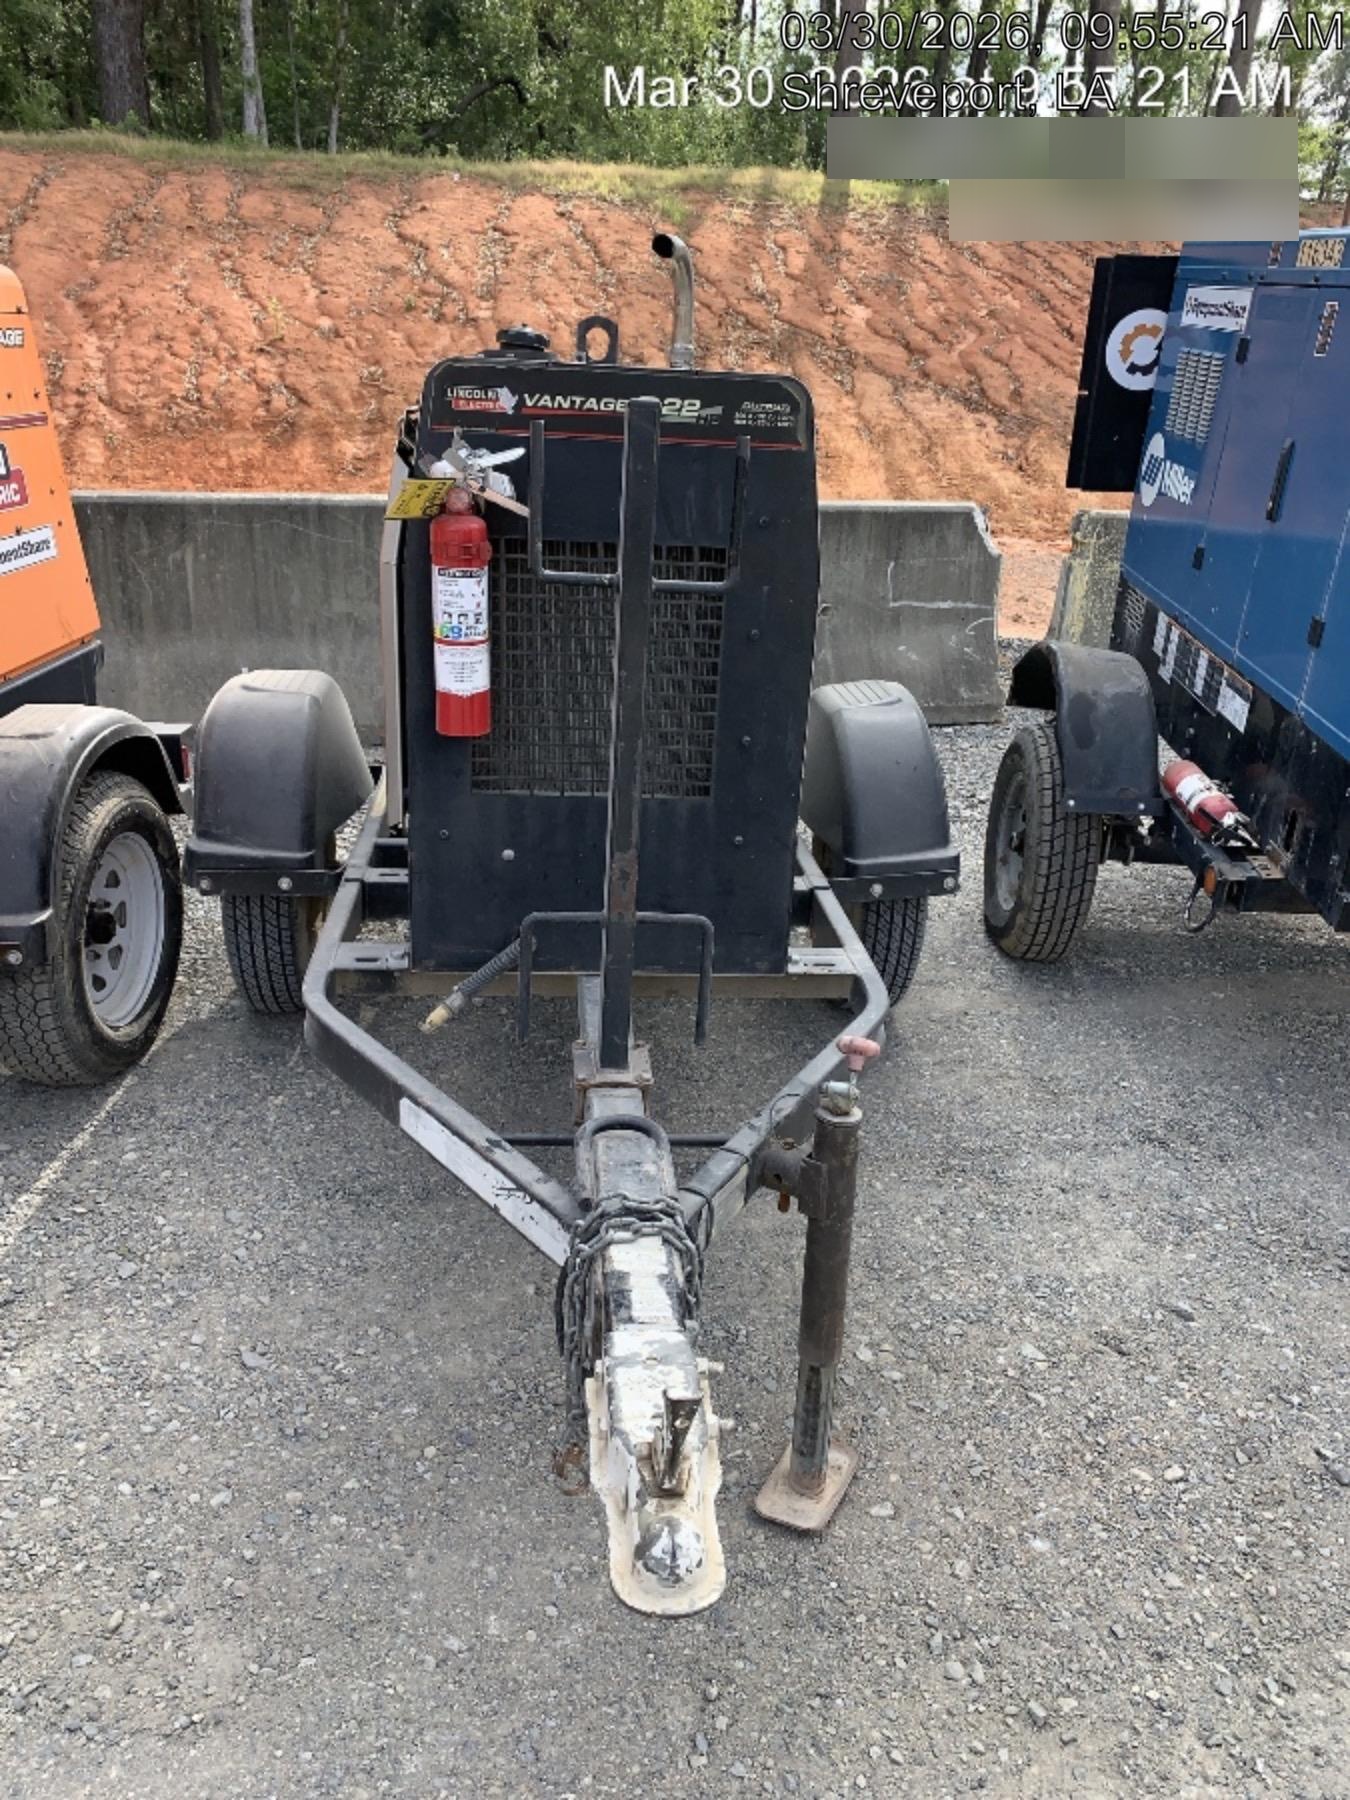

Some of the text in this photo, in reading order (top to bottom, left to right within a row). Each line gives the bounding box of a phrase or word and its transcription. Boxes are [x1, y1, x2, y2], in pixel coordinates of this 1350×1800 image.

[447, 386, 498, 400] LINCOLN
[523, 393, 701, 417] VANTAGE 22
